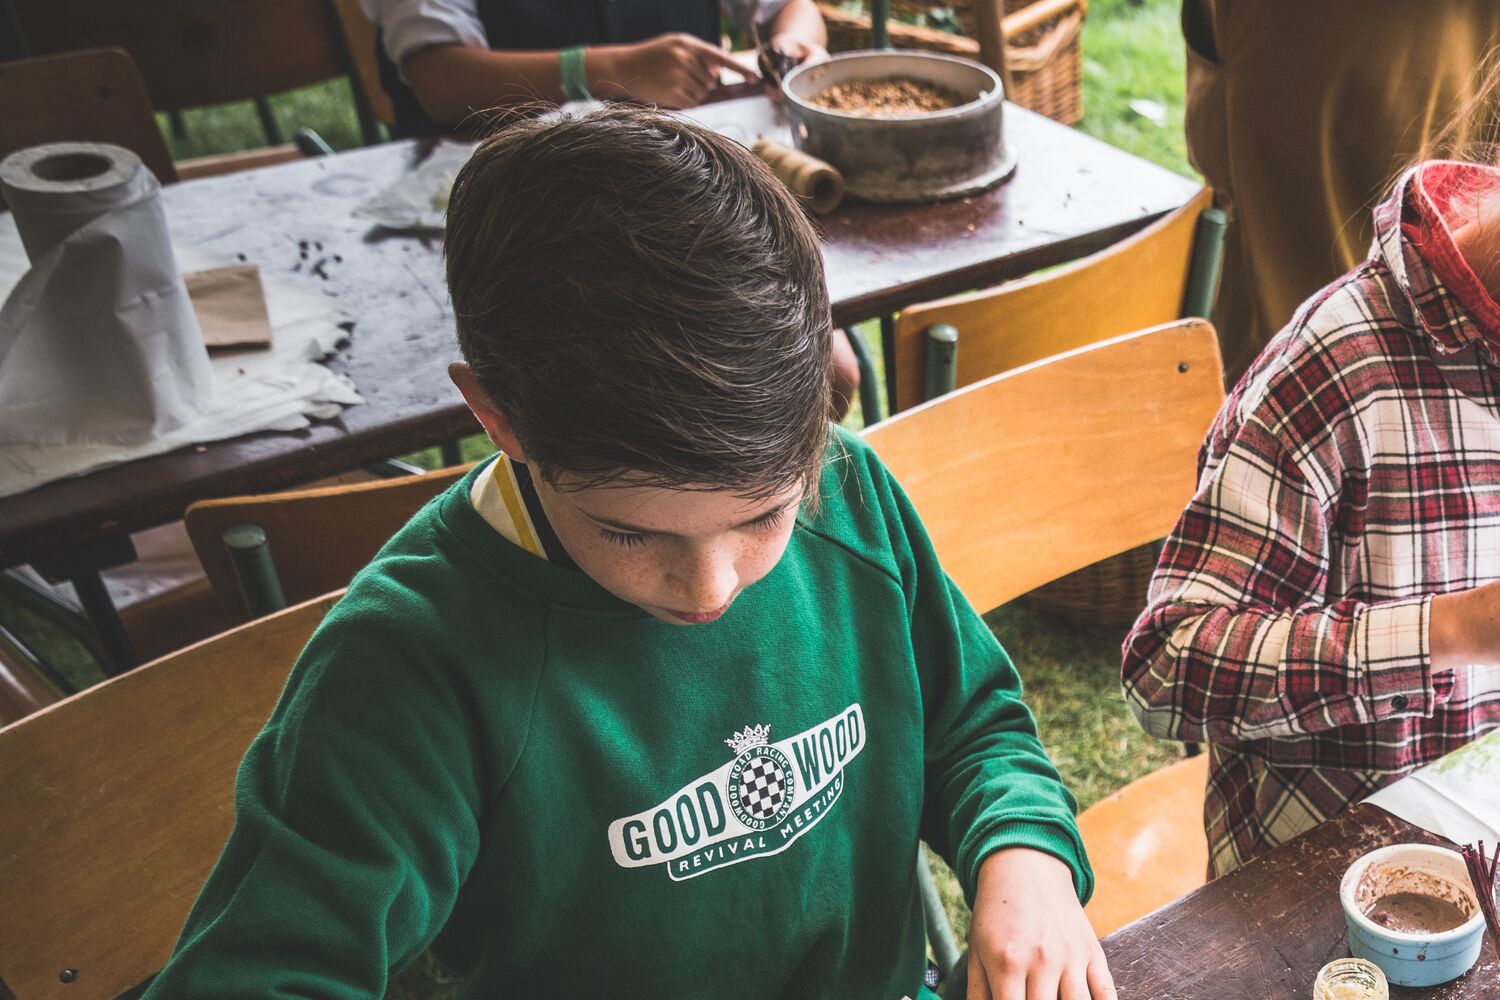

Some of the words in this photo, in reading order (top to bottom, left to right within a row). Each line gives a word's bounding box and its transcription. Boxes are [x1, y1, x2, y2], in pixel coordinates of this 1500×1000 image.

[732, 752, 752, 779] ROAD
[756, 747, 788, 768] RACING
[622, 781, 726, 860] GOOD
[791, 709, 859, 793] WOOD
[729, 784, 765, 829] GOODWOOD
[774, 770, 795, 823] COMPANY
[679, 836, 767, 872] REVIVAL
[780, 778, 841, 838] MEETING
